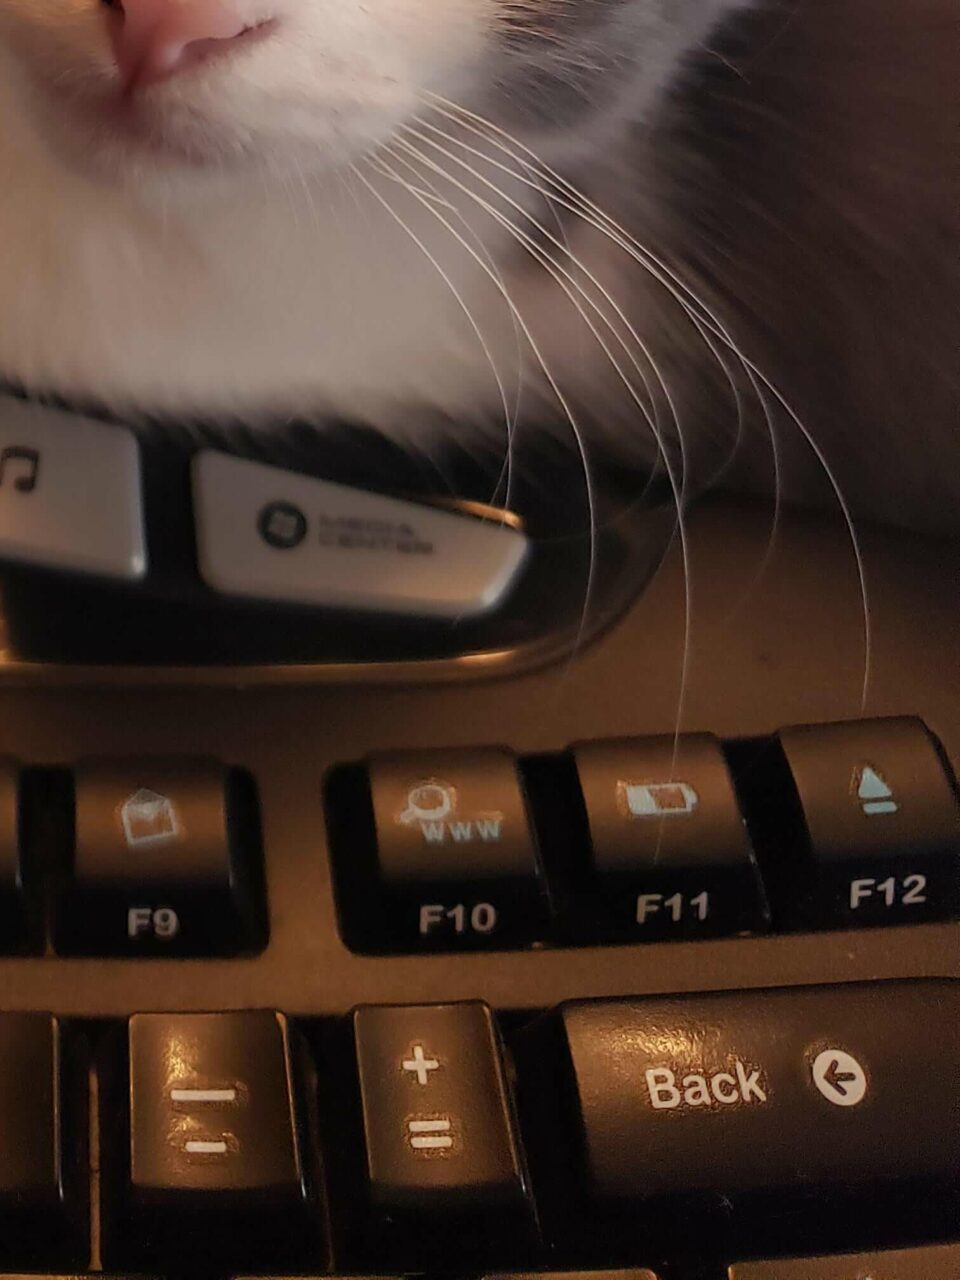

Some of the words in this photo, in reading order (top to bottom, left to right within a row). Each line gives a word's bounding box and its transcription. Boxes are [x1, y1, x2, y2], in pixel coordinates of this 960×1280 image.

[637, 891, 710, 924] F11
[849, 874, 927, 908] F12
[127, 907, 179, 937] F9
[419, 902, 497, 934] F10
[645, 1058, 767, 1109] Back
